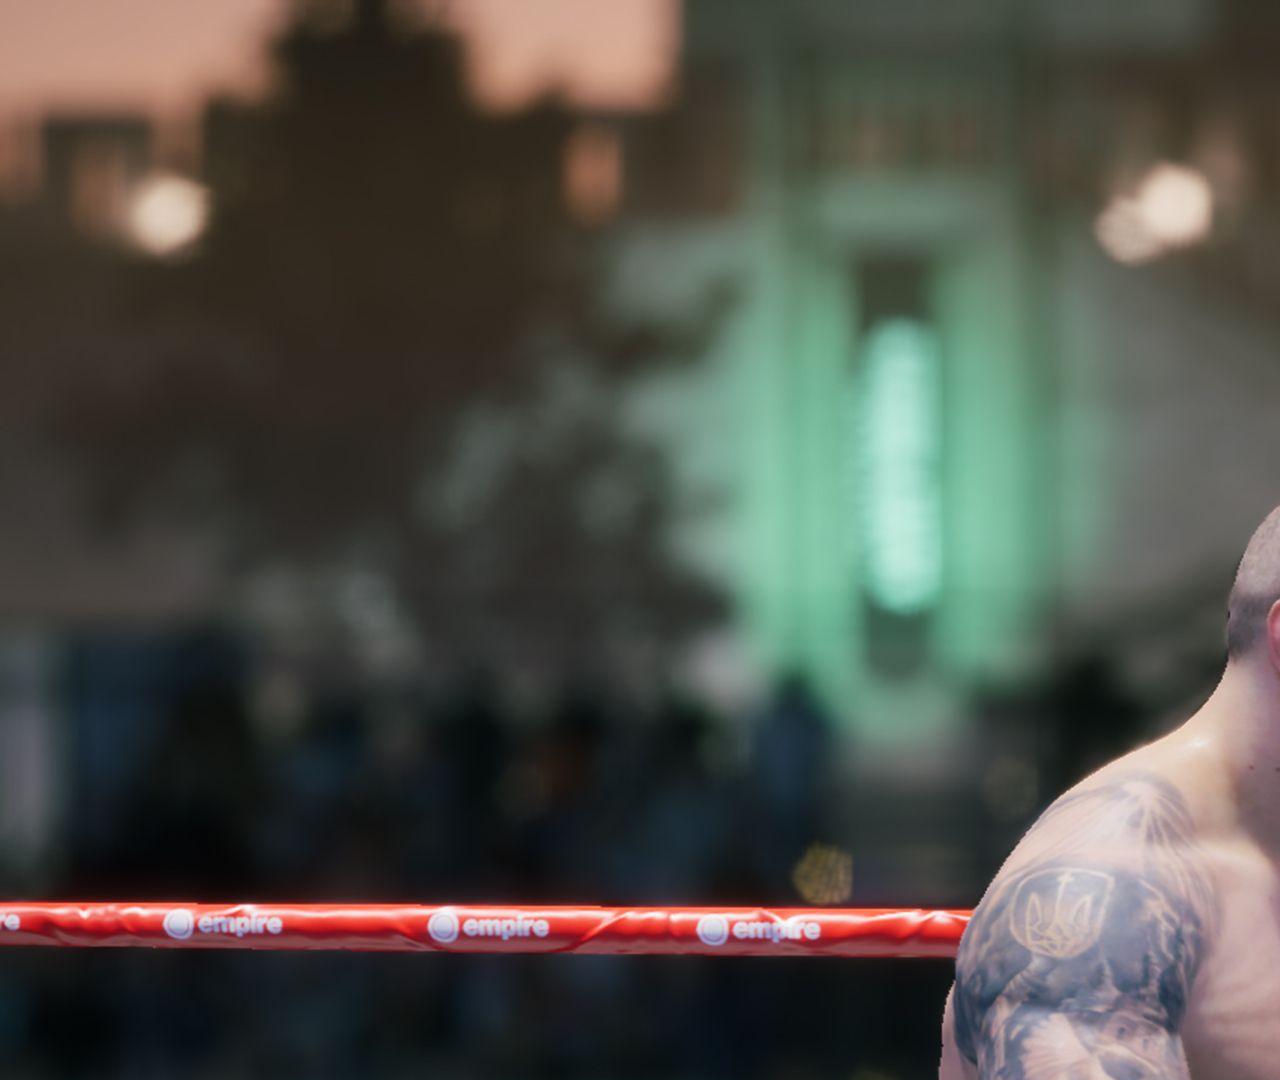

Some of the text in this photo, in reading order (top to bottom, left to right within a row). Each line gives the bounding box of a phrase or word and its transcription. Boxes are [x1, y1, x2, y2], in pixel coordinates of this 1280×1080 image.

[199, 914, 282, 935] empire
[463, 916, 548, 938] empire
[733, 919, 820, 941] empire
